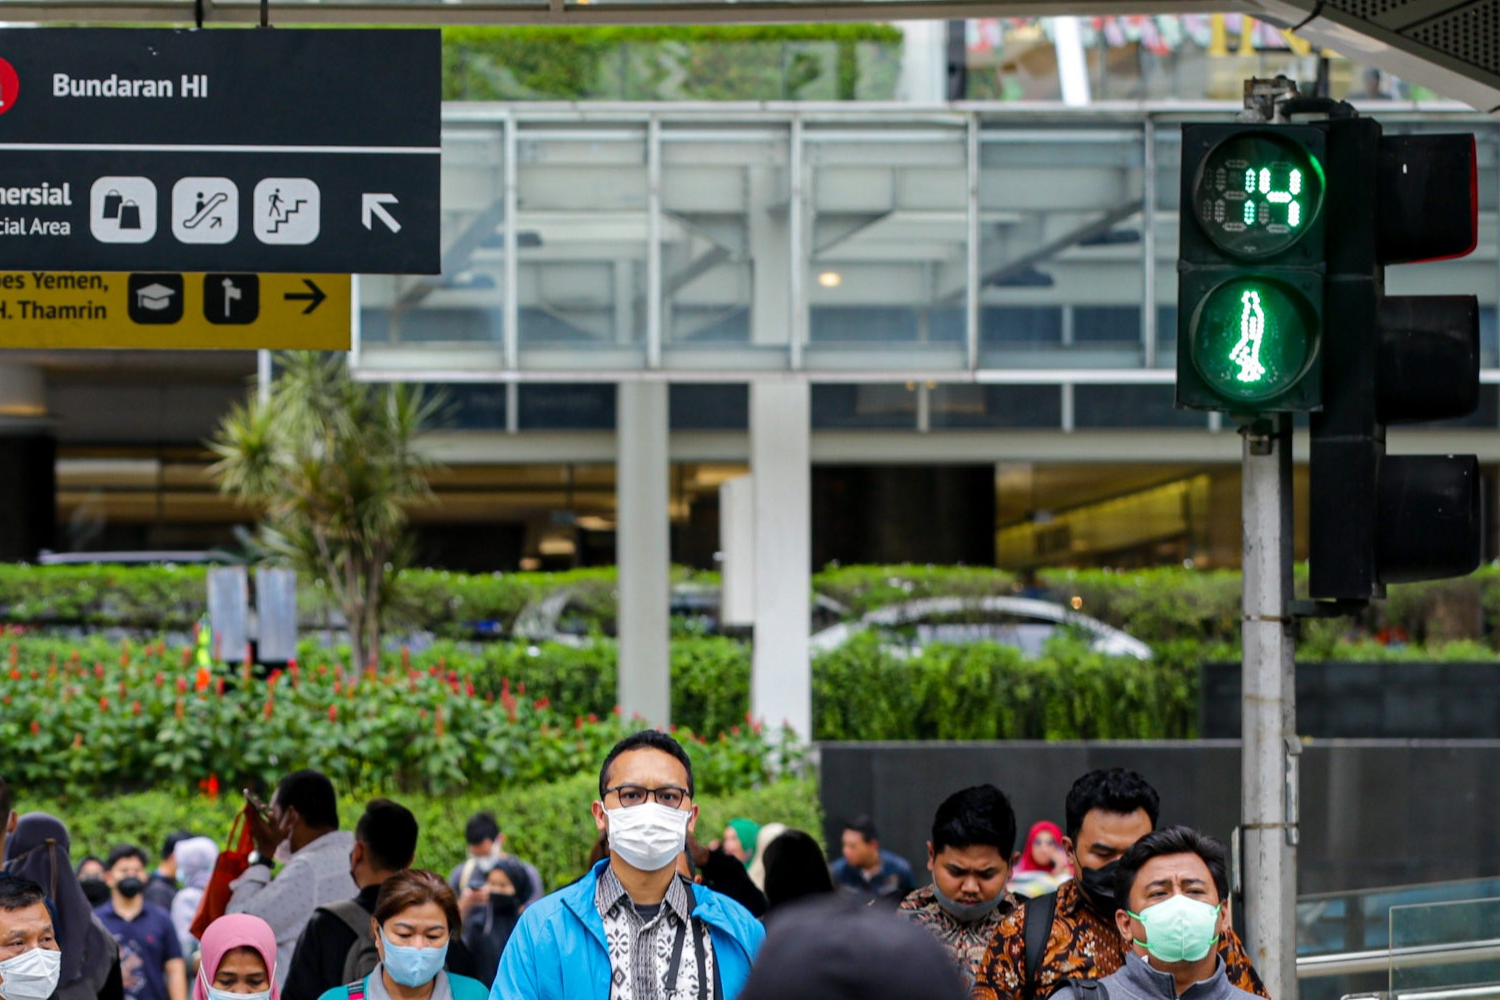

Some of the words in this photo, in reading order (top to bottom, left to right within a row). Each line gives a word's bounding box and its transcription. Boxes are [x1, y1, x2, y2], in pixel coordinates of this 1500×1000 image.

[52, 73, 174, 98] Bundaran
[180, 74, 209, 98] HI
[1243, 167, 1302, 227] 14
[29, 217, 71, 236] Area
[31, 272, 109, 292] Yemen,
[17, 301, 107, 319] Thamrin
